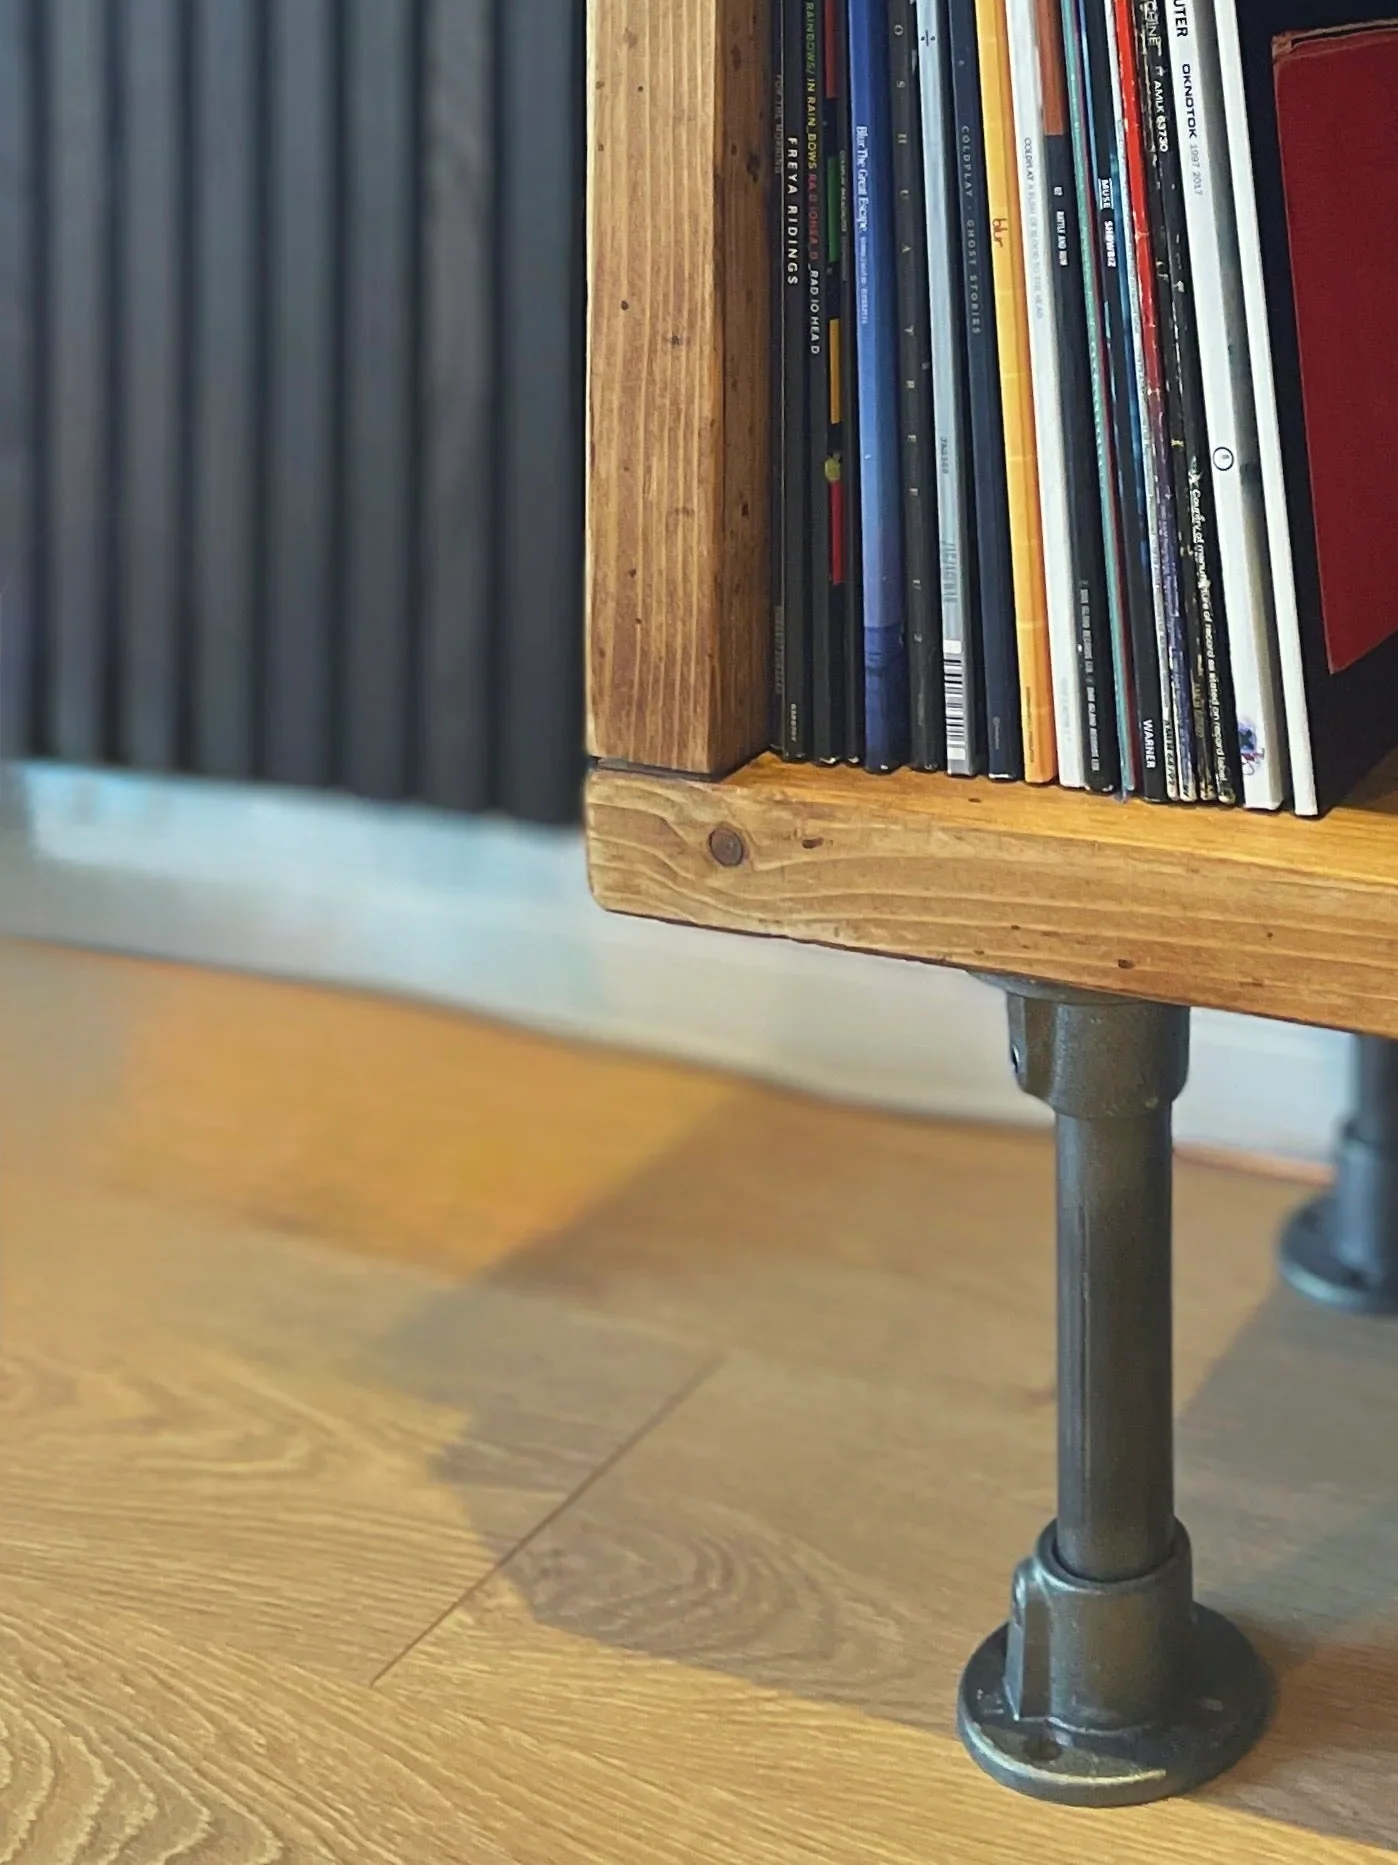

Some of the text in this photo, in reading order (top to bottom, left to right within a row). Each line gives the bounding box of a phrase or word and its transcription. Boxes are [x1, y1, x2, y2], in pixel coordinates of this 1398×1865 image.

[806, 79, 816, 92] IN
[1152, 80, 1165, 113] AMLK
[1182, 63, 1197, 139] OKNOTOK
[856, 126, 868, 147] Blur
[1156, 114, 1169, 153] 63730
[857, 147, 868, 167] The
[1024, 137, 1035, 182] COLDPLAY
[1189, 144, 1200, 169] 1997
[857, 169, 869, 195] Great
[1192, 171, 1203, 196] 2017
[787, 137, 799, 285] FREYA RIDINGS
[856, 197, 870, 231] Escape
[1101, 178, 1116, 267] MUSE SHOWBIZ
[960, 125, 982, 334] COLDPLAY GHOST STORIES
[992, 217, 1008, 248] blur
[1190, 488, 1206, 529] Country
[1203, 624, 1217, 658] record
[1208, 672, 1221, 706] stated
[1211, 706, 1221, 720] on
[1142, 719, 1156, 769] WARNER
[1213, 721, 1225, 756] record
